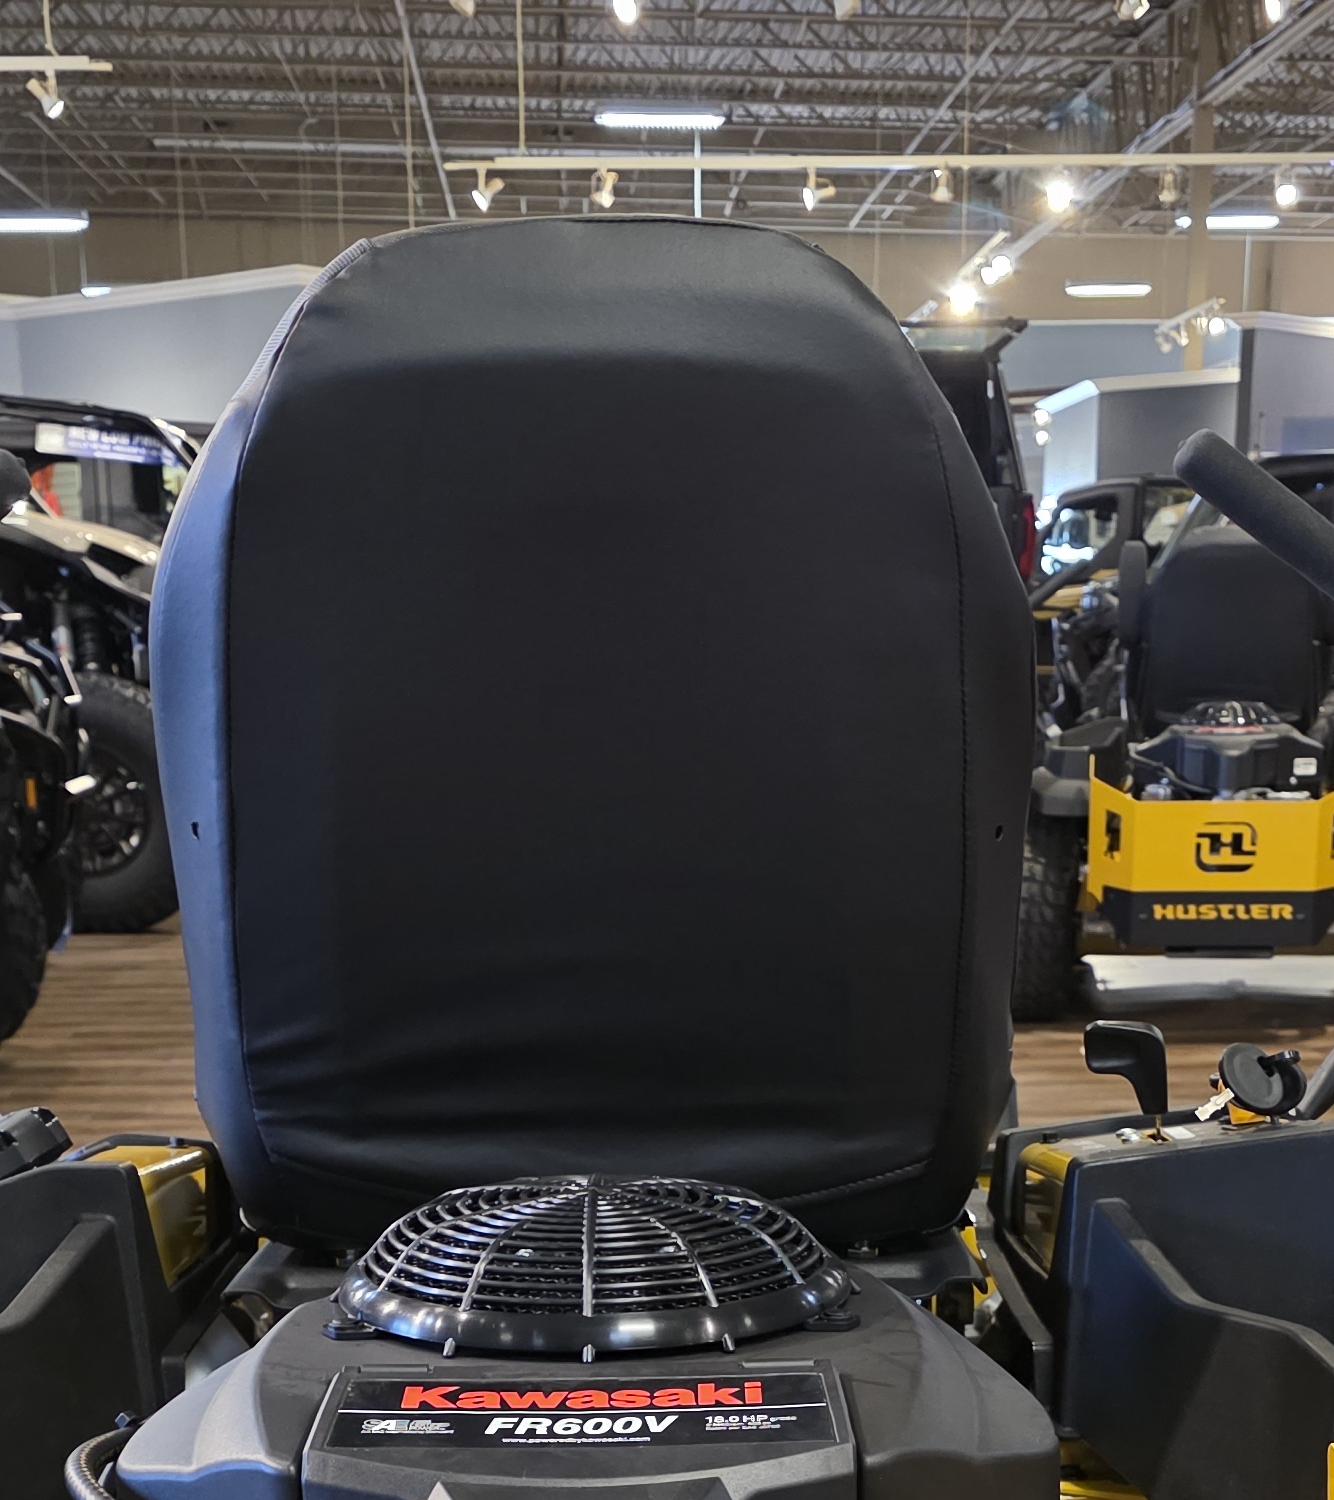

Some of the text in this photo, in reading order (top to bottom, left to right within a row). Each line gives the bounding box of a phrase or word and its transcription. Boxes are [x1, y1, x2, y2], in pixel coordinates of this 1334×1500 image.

[1152, 903, 1294, 920] HUSTLER
[400, 1381, 763, 1410] Kawasaki
[483, 1414, 680, 1436] FR600V
